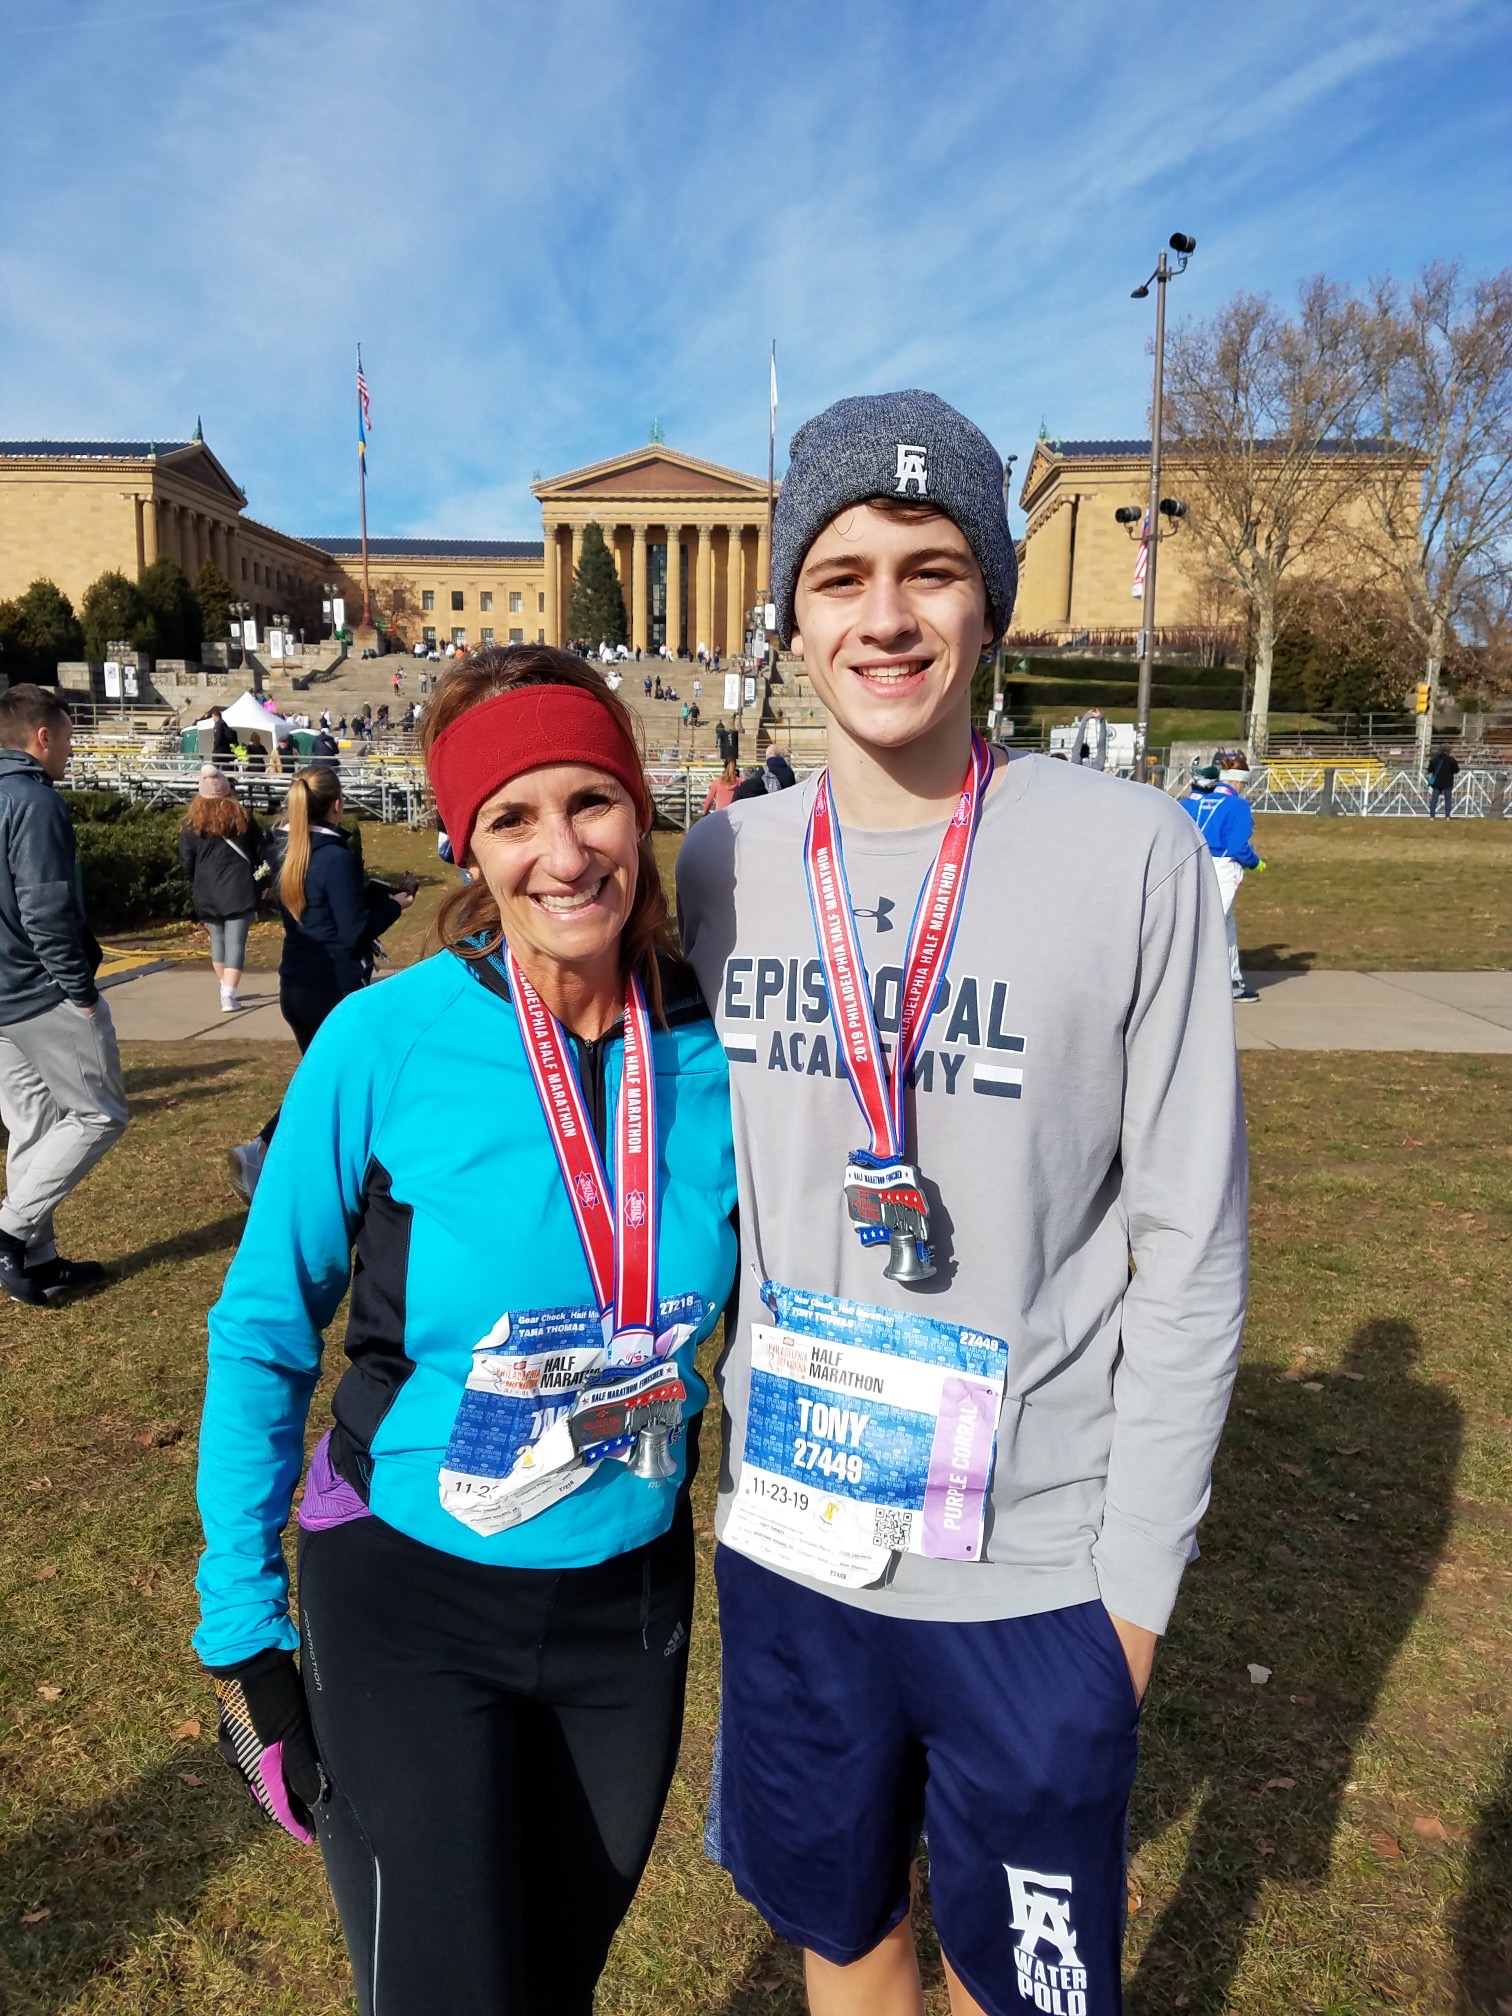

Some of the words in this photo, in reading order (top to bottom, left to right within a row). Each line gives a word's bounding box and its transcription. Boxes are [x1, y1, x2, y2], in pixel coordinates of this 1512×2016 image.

[816, 846, 837, 911] MARATHON
[929, 863, 957, 931] MARATHON
[827, 913, 844, 943] HALF
[920, 933, 939, 964] HALF
[518, 965, 549, 1039] LADELPHIA
[724, 955, 1028, 1055] EPISOAL
[833, 944, 862, 1029] PHILADELPHIA
[902, 967, 930, 1043] ILADELPHIA
[538, 1040, 557, 1069] HALF
[768, 1030, 966, 1096] ACAMY
[851, 1031, 868, 1062] 2019
[625, 1055, 641, 1084] HALF
[547, 1073, 578, 1138] MARATHON
[627, 1088, 642, 1154] MARATHON
[518, 1316, 539, 1324] Gear
[541, 1312, 566, 1322] Check
[570, 1311, 586, 1319] Half
[659, 1295, 694, 1315] 27218
[519, 1329, 544, 1338] TANA
[546, 1323, 586, 1334] THOMAS
[960, 1331, 999, 1352] 27449
[540, 1368, 601, 1388] MARAT
[544, 1356, 576, 1373] HALF
[809, 1362, 884, 1394] MARATHON
[811, 1346, 844, 1367] HALF
[797, 1397, 870, 1448] TONY
[952, 1406, 978, 1472] CORRAL
[793, 1437, 864, 1485] 27449
[752, 1477, 810, 1511] 11-23-19
[943, 1472, 968, 1531] PURPLE
[1013, 1946, 1087, 1990] WATER
[1017, 1970, 1087, 2016] POLO
